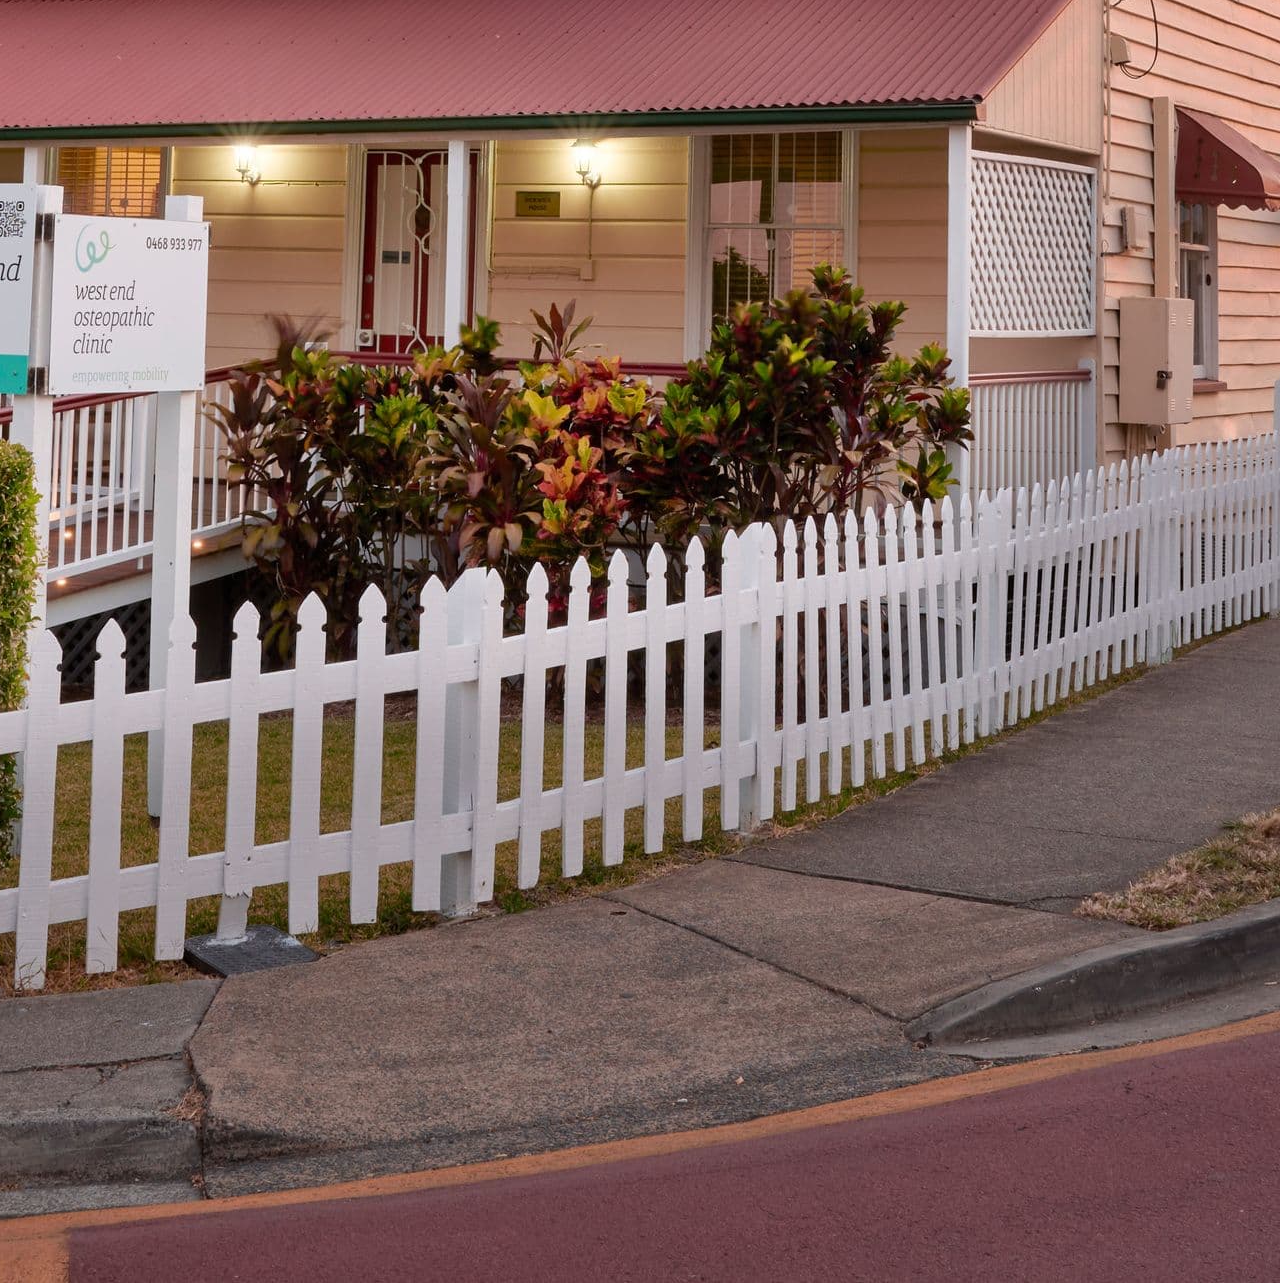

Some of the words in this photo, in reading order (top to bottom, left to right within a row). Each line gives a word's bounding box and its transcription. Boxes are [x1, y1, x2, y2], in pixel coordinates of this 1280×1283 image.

[146, 236, 168, 250] 0468
[170, 237, 186, 251] 933
[188, 238, 202, 252] 977
[74, 283, 109, 300] west
[109, 280, 135, 301] end
[74, 307, 155, 331] osteopathic
[73, 333, 113, 355] clinic
[72, 370, 129, 385] empowering
[132, 367, 169, 383] mobility
